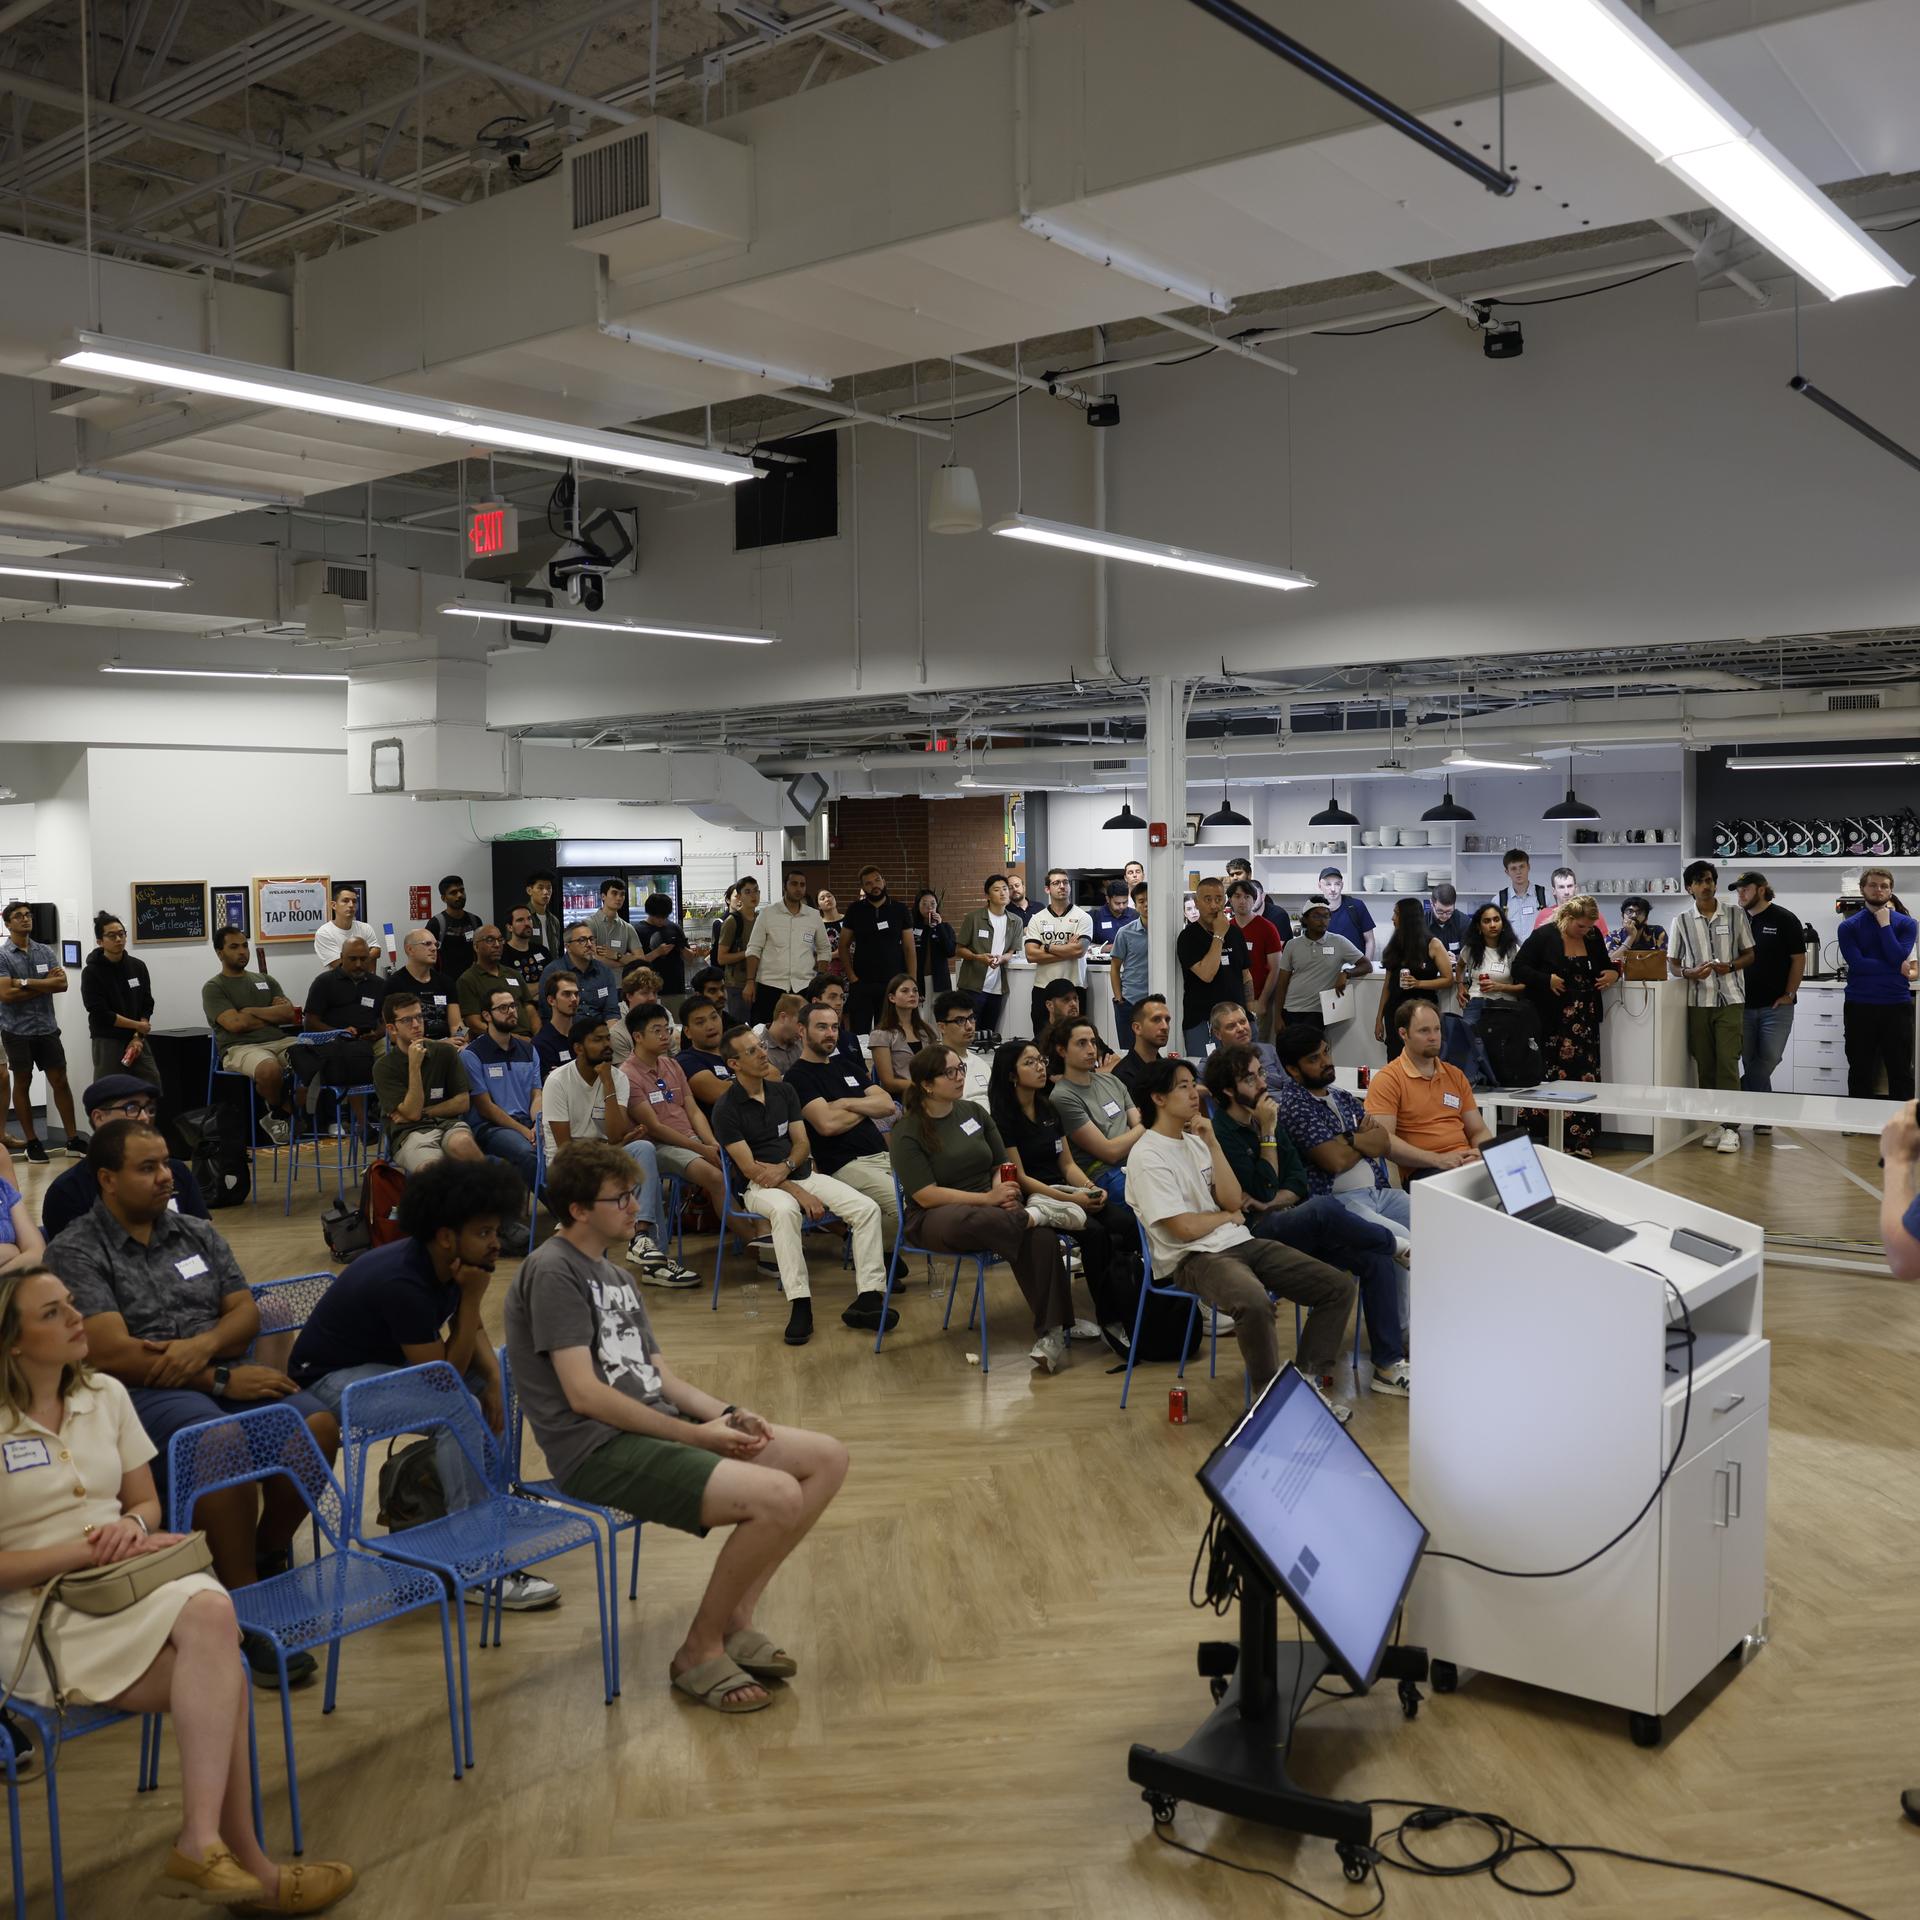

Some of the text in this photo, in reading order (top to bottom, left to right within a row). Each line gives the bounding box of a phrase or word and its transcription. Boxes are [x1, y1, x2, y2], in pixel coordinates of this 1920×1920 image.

[474, 511, 504, 553] EXIT
[287, 899, 301, 910] TC
[265, 909, 323, 923] TAP ROOM
[1040, 932, 1074, 940] TOYOT
